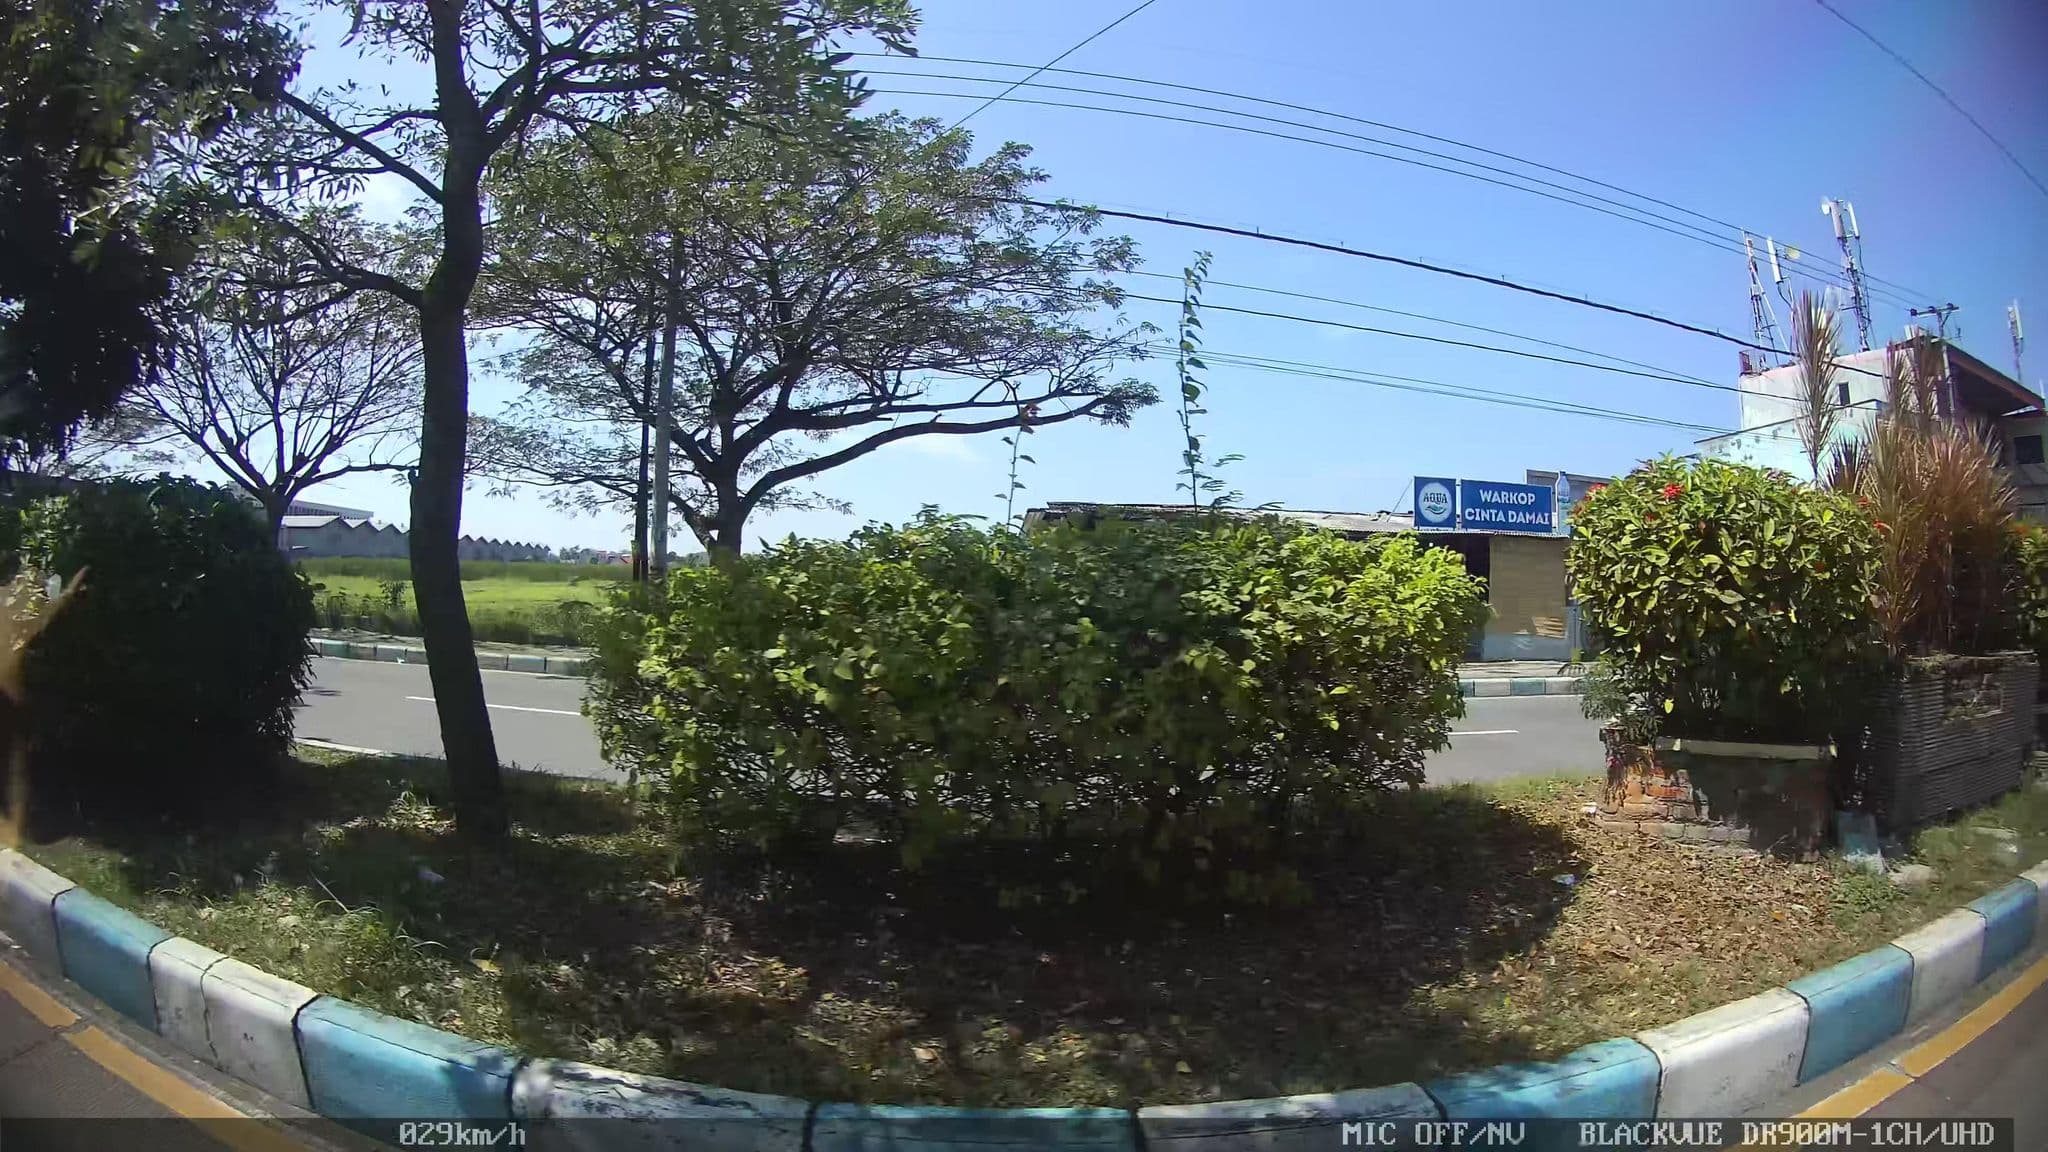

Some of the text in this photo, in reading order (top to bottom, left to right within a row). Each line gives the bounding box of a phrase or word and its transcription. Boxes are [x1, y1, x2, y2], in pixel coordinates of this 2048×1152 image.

[1423, 492, 1448, 504] AQUA
[1479, 489, 1536, 506] WARKOP
[1464, 507, 1550, 526] CINTA DAMAI
